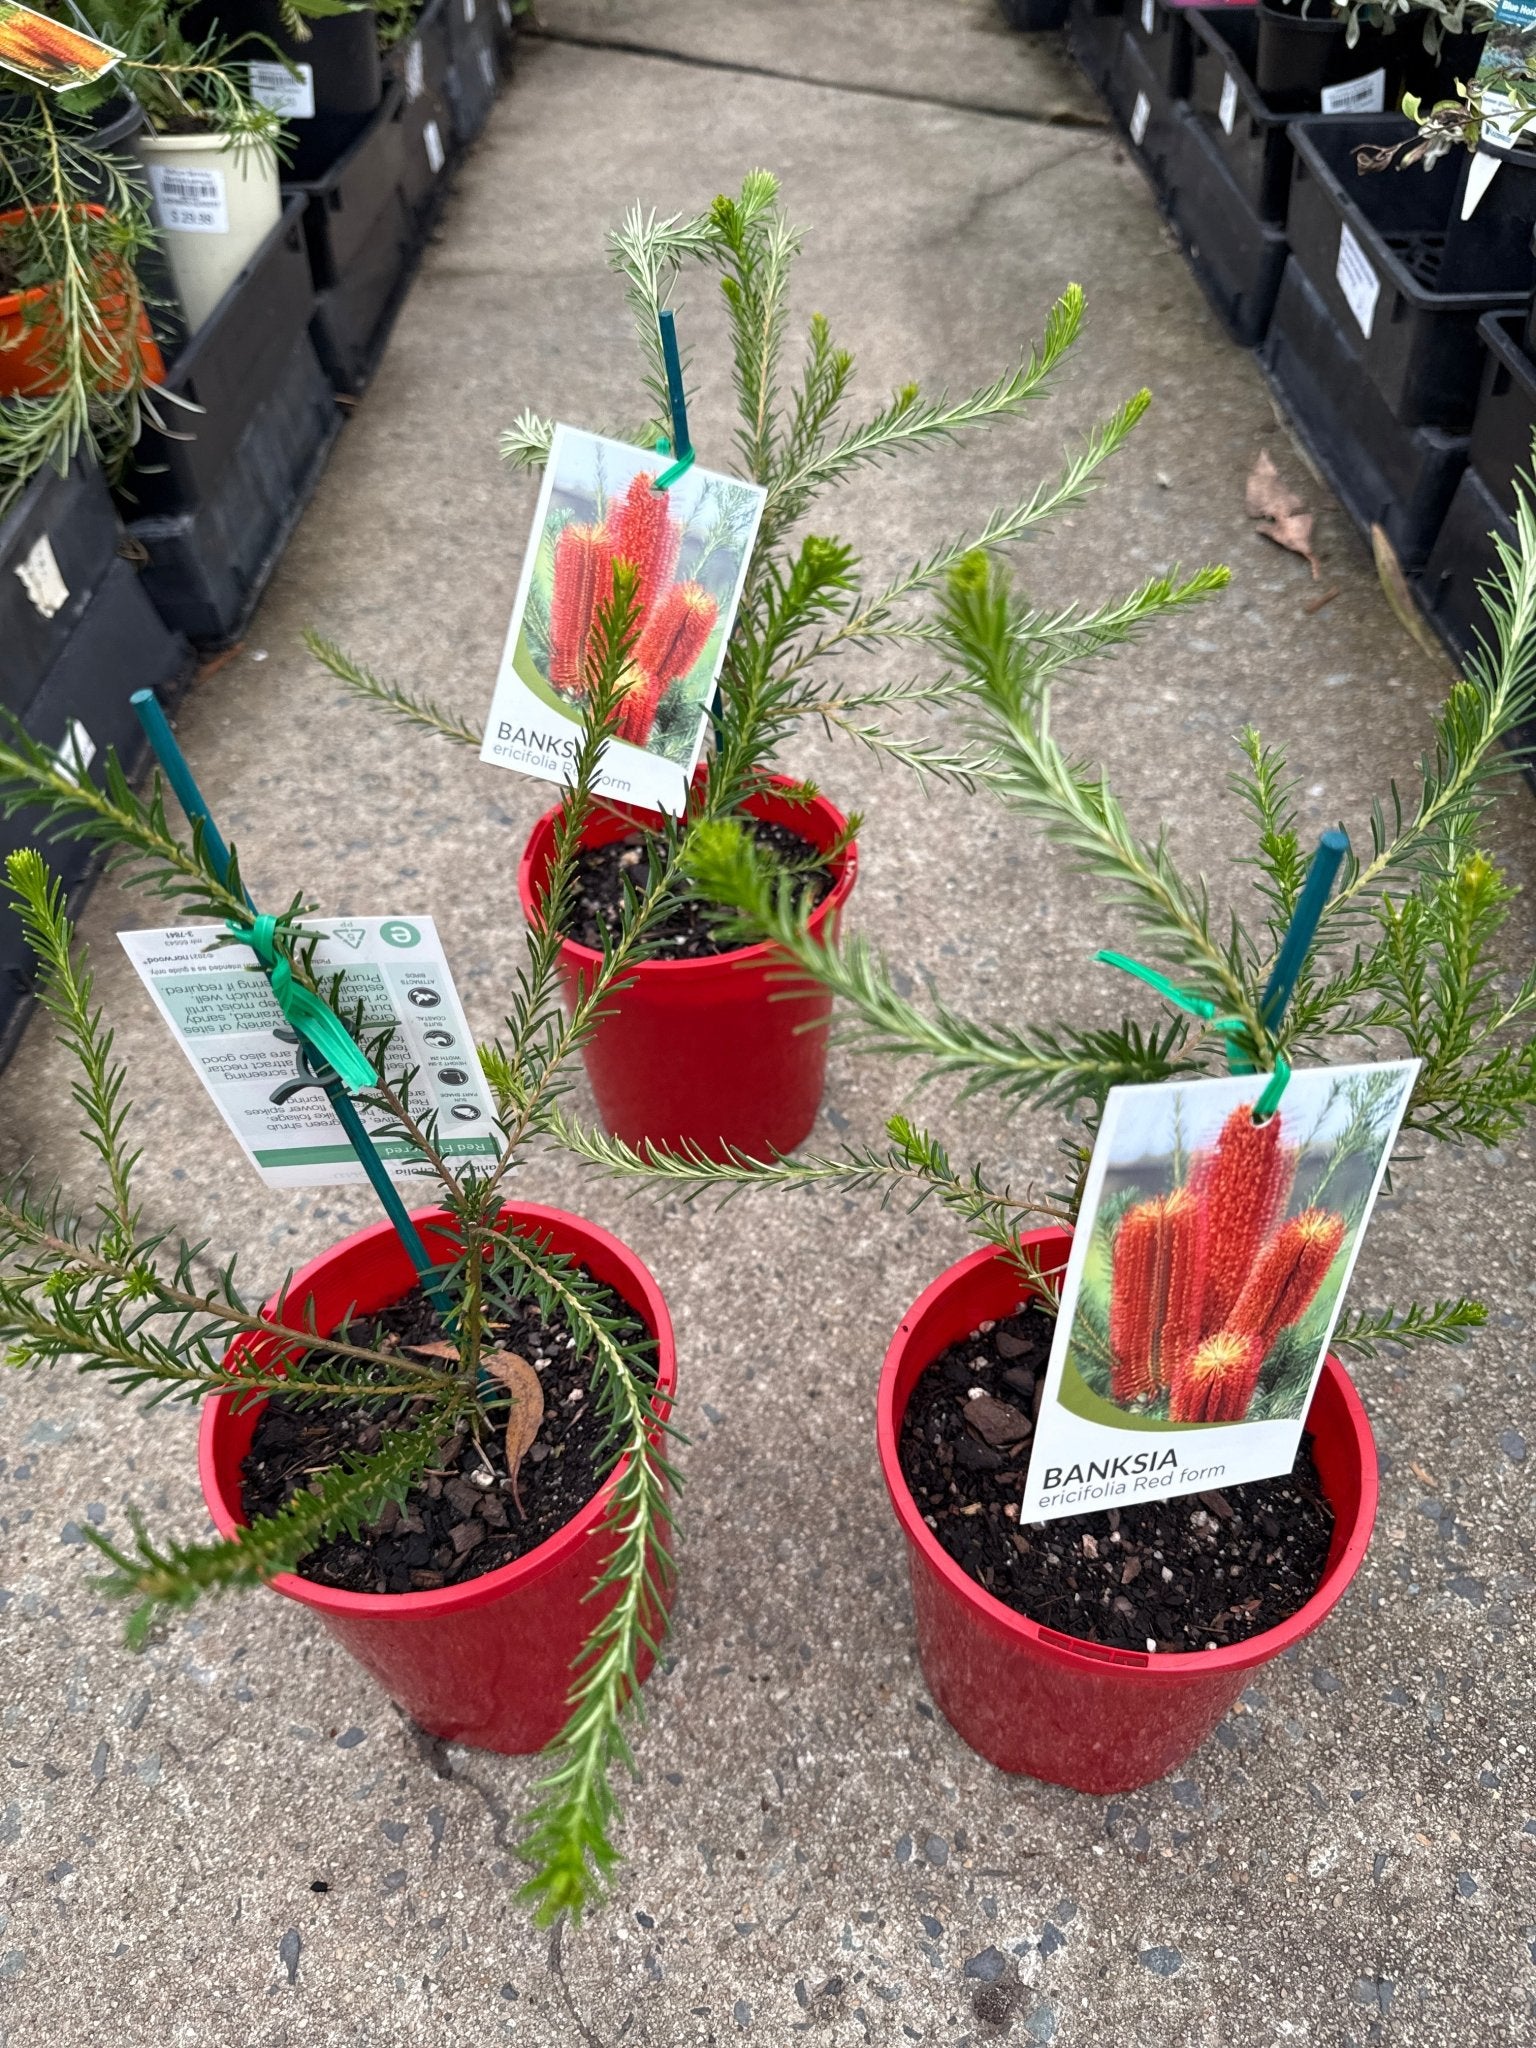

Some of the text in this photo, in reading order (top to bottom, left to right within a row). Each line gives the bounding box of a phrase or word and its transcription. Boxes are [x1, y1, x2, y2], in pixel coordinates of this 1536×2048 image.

[1502, 0, 1519, 12] Blue
[497, 721, 579, 759] BANKS
[493, 743, 557, 771] ericifolia
[599, 773, 631, 792] orm
[169, 966, 188, 974] guide
[160, 983, 221, 996] required.
[226, 983, 235, 992] if
[191, 994, 221, 1004] well.
[226, 991, 267, 1002] mulch
[184, 1006, 213, 1016] until
[216, 1002, 254, 1012] moist
[370, 1004, 392, 1012] but
[186, 1015, 225, 1024] sandy
[184, 1026, 215, 1034] sites
[219, 1024, 232, 1032] of
[236, 1020, 280, 1031] variety
[201, 1054, 236, 1065] good
[240, 1053, 266, 1062] also
[271, 1051, 291, 1059] are
[208, 1064, 248, 1073] nectar
[252, 1060, 293, 1070] attract
[224, 1071, 287, 1082] screening
[244, 1106, 284, 1116] spikes
[290, 1104, 326, 1112] flower
[266, 1123, 302, 1131] shrub
[458, 1143, 485, 1151] Red
[1042, 1448, 1178, 1490] BANKSIA
[1038, 1464, 1226, 1508] ericifolia Red form
